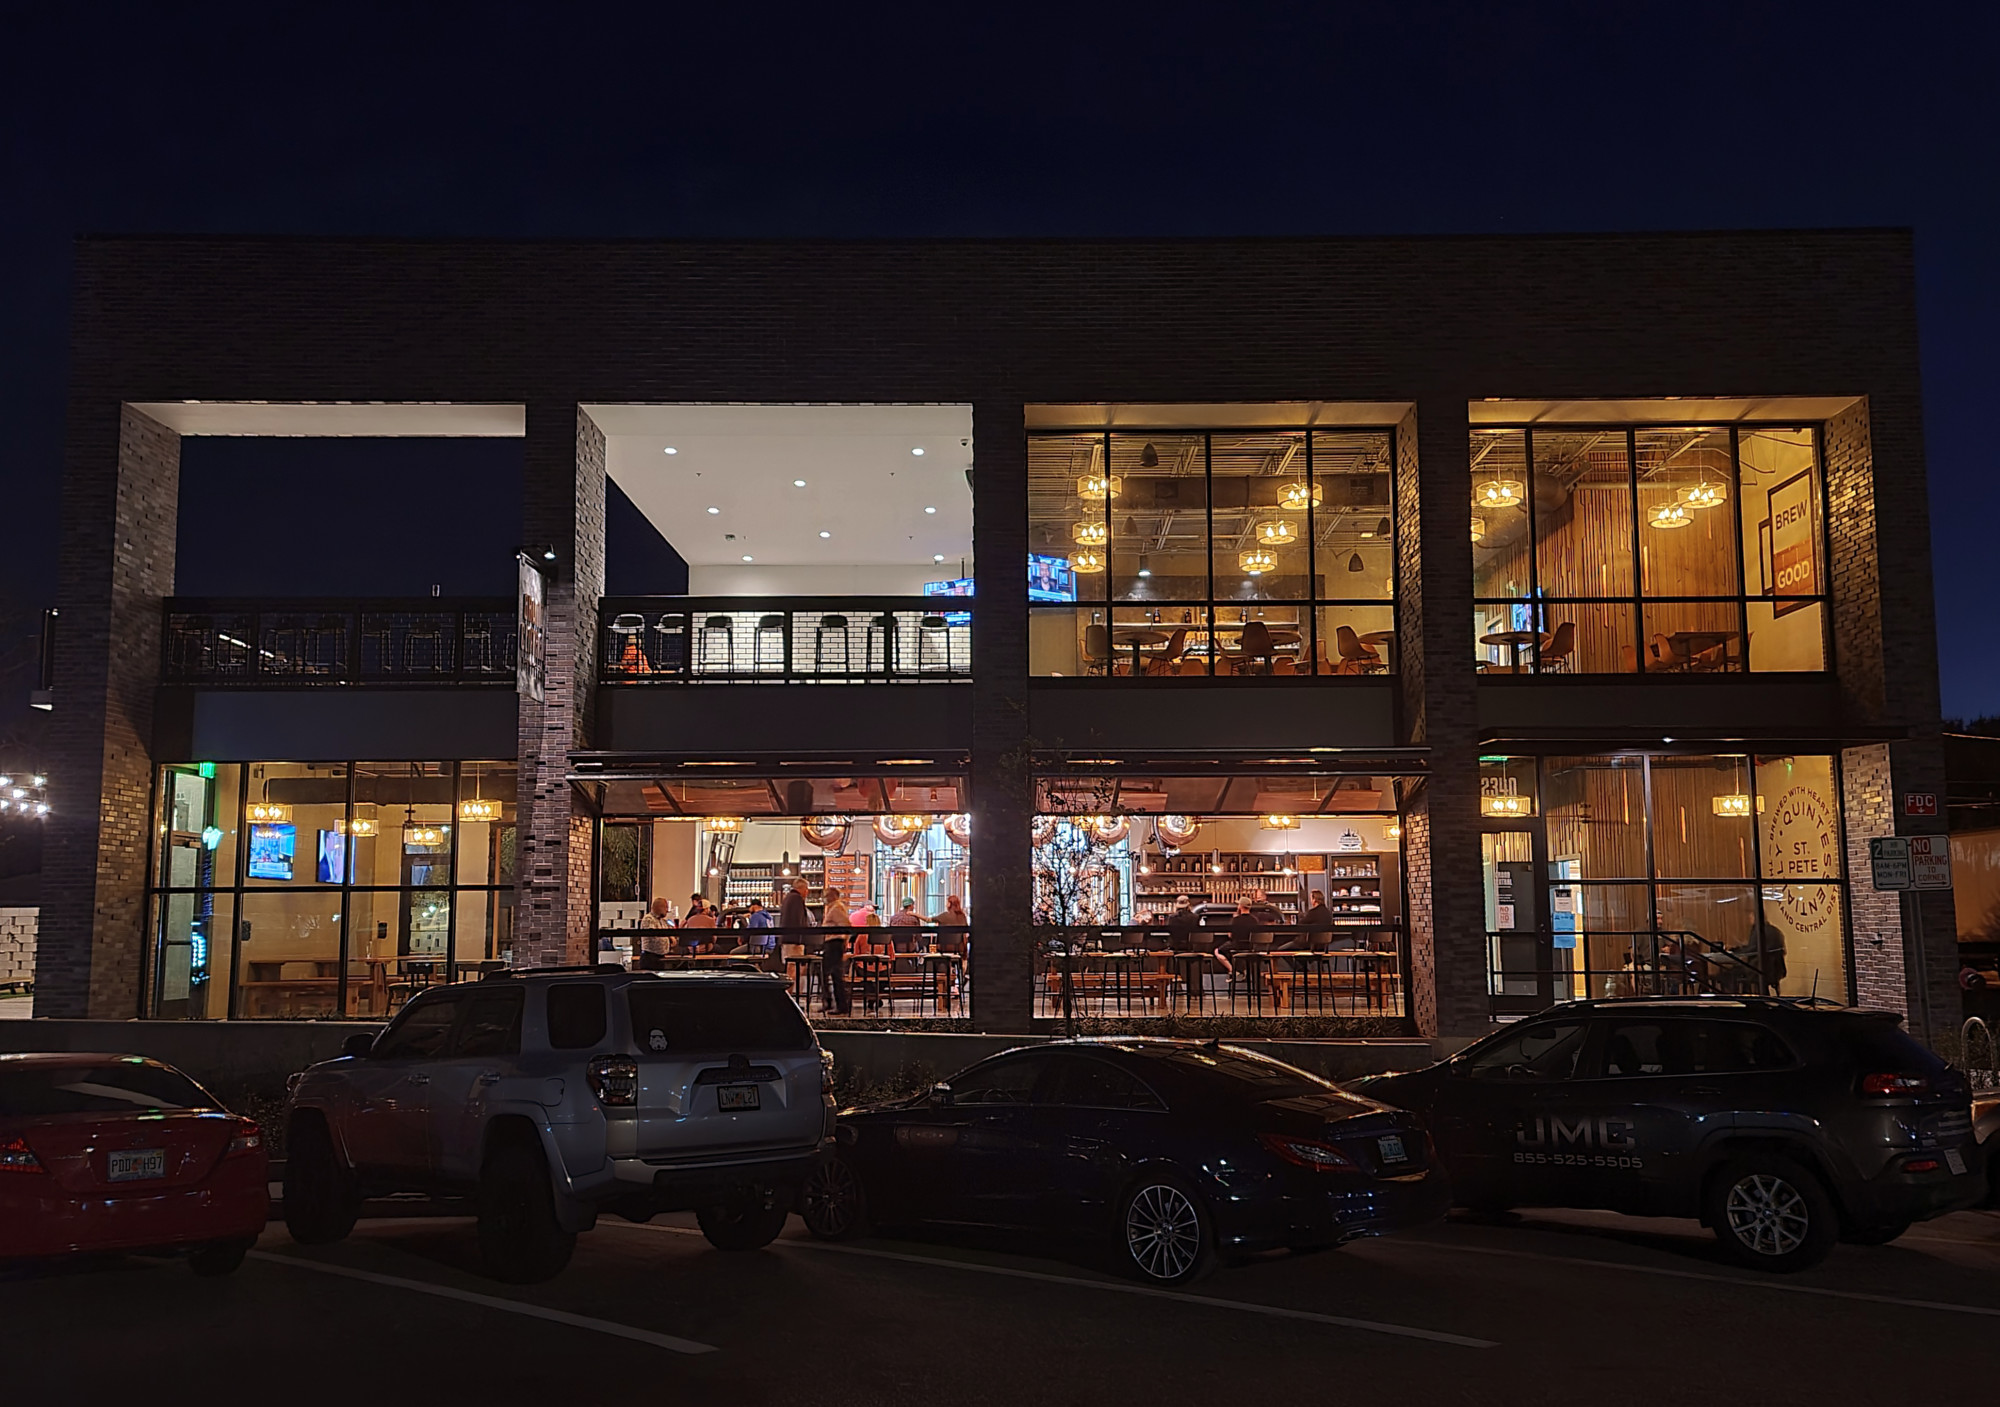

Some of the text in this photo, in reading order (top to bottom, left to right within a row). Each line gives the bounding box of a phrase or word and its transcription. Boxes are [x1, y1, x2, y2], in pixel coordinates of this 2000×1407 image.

[1775, 500, 1808, 530] BREW
[1777, 560, 1810, 589] GOOD
[1480, 777, 1517, 797] 2340
[1907, 795, 1934, 807] FDC
[1769, 795, 1788, 841] BREWED
[1787, 786, 1806, 798] WITH
[1807, 787, 1829, 816] HEART
[1793, 842, 1811, 855] ST.
[1873, 843, 1882, 858] 2
[1912, 839, 1930, 853] NO
[1788, 859, 1818, 874] PETE
[1914, 855, 1947, 866] PARKING
[1795, 916, 1828, 933] CENTRAL
[143, 1156, 162, 1170] H97
